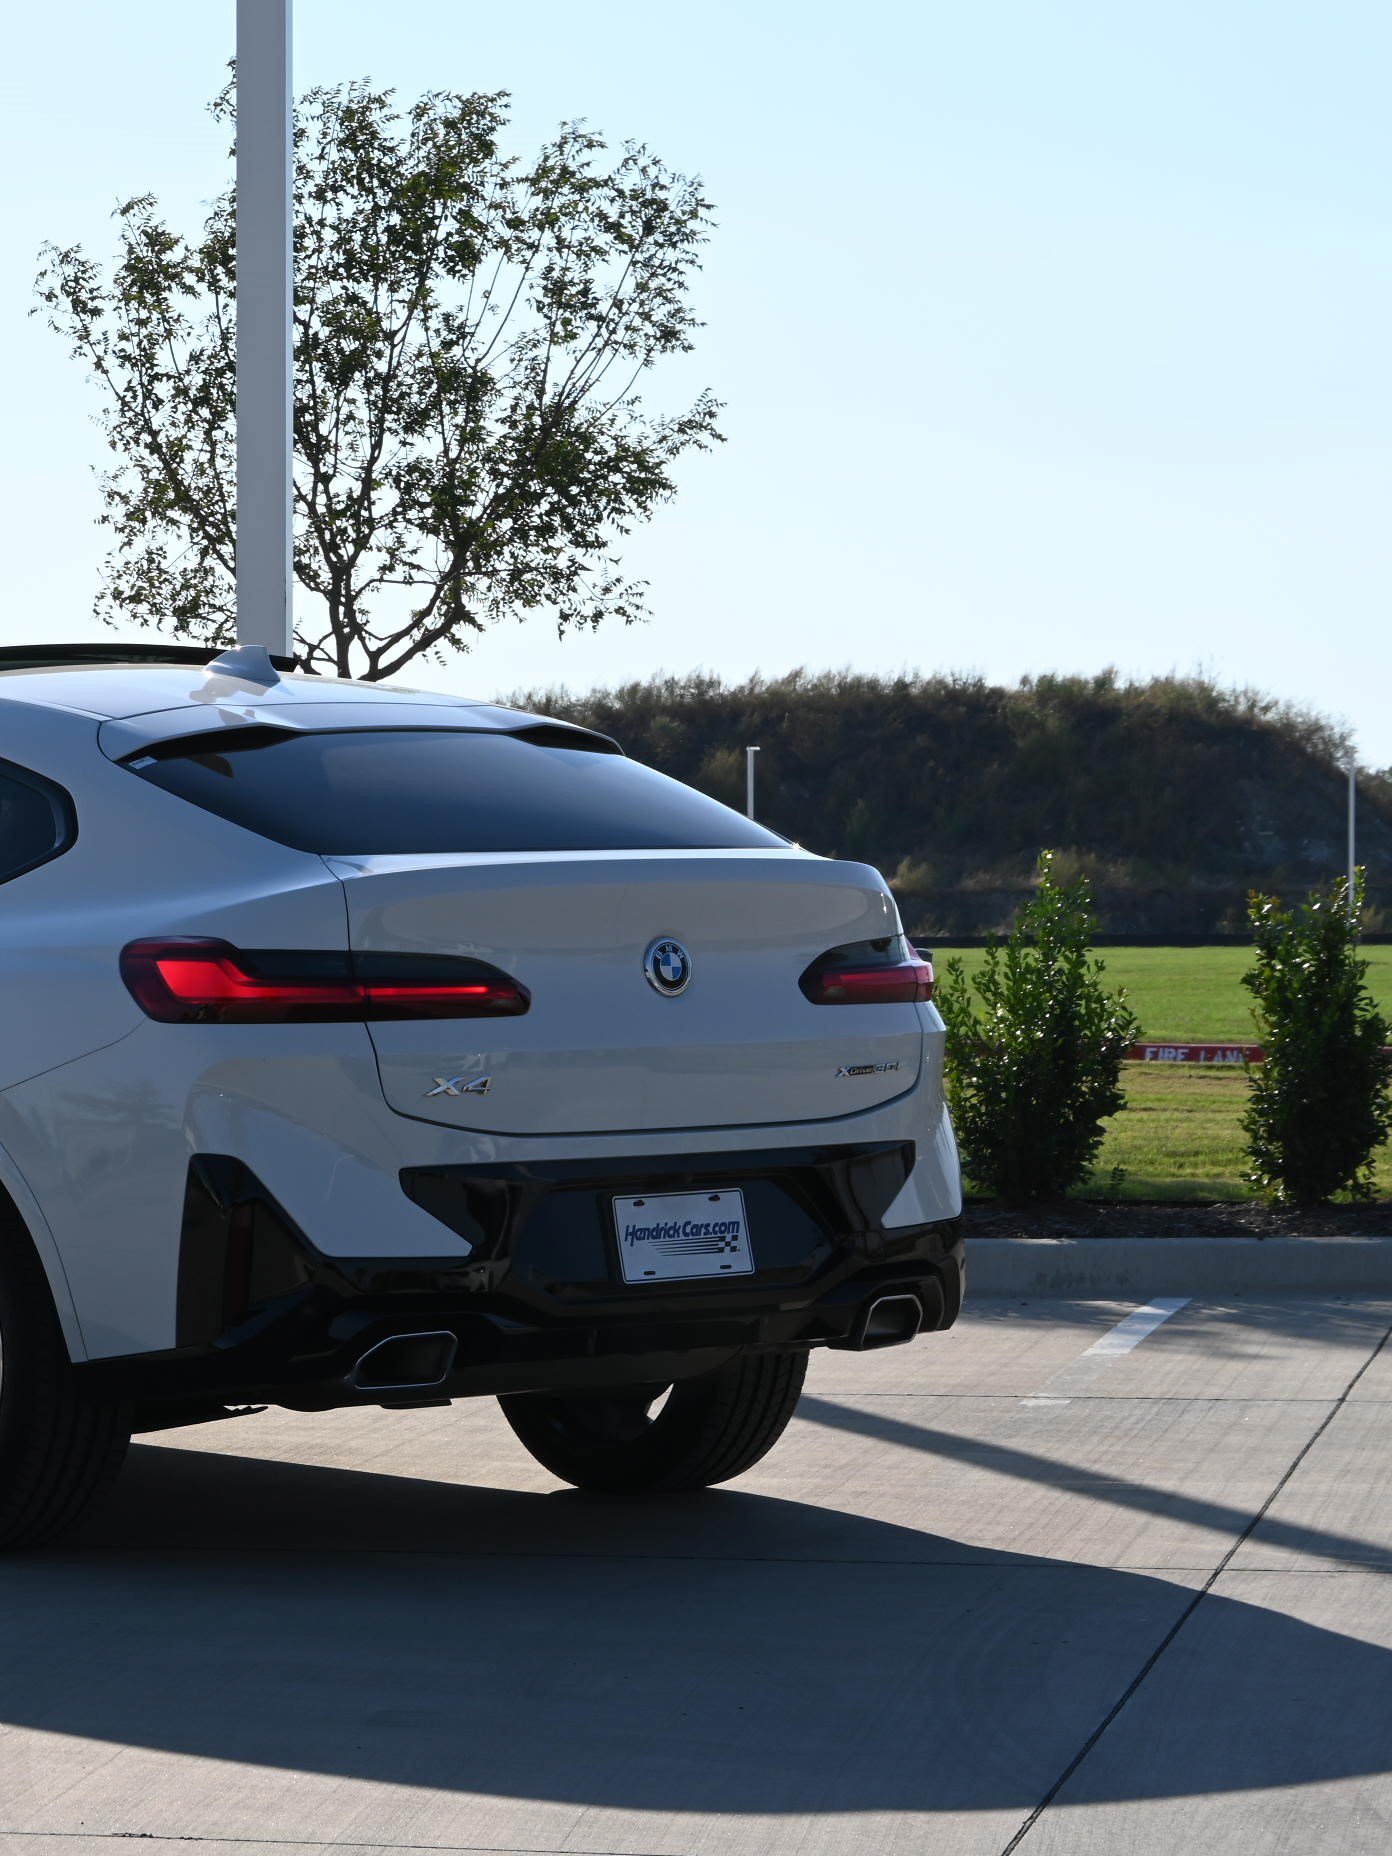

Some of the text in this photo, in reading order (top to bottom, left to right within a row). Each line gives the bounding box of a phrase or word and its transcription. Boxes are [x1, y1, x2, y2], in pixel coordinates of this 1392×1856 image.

[656, 945, 685, 959] BMW
[1145, 1048, 1189, 1061] FIRE
[425, 1076, 492, 1096] X4
